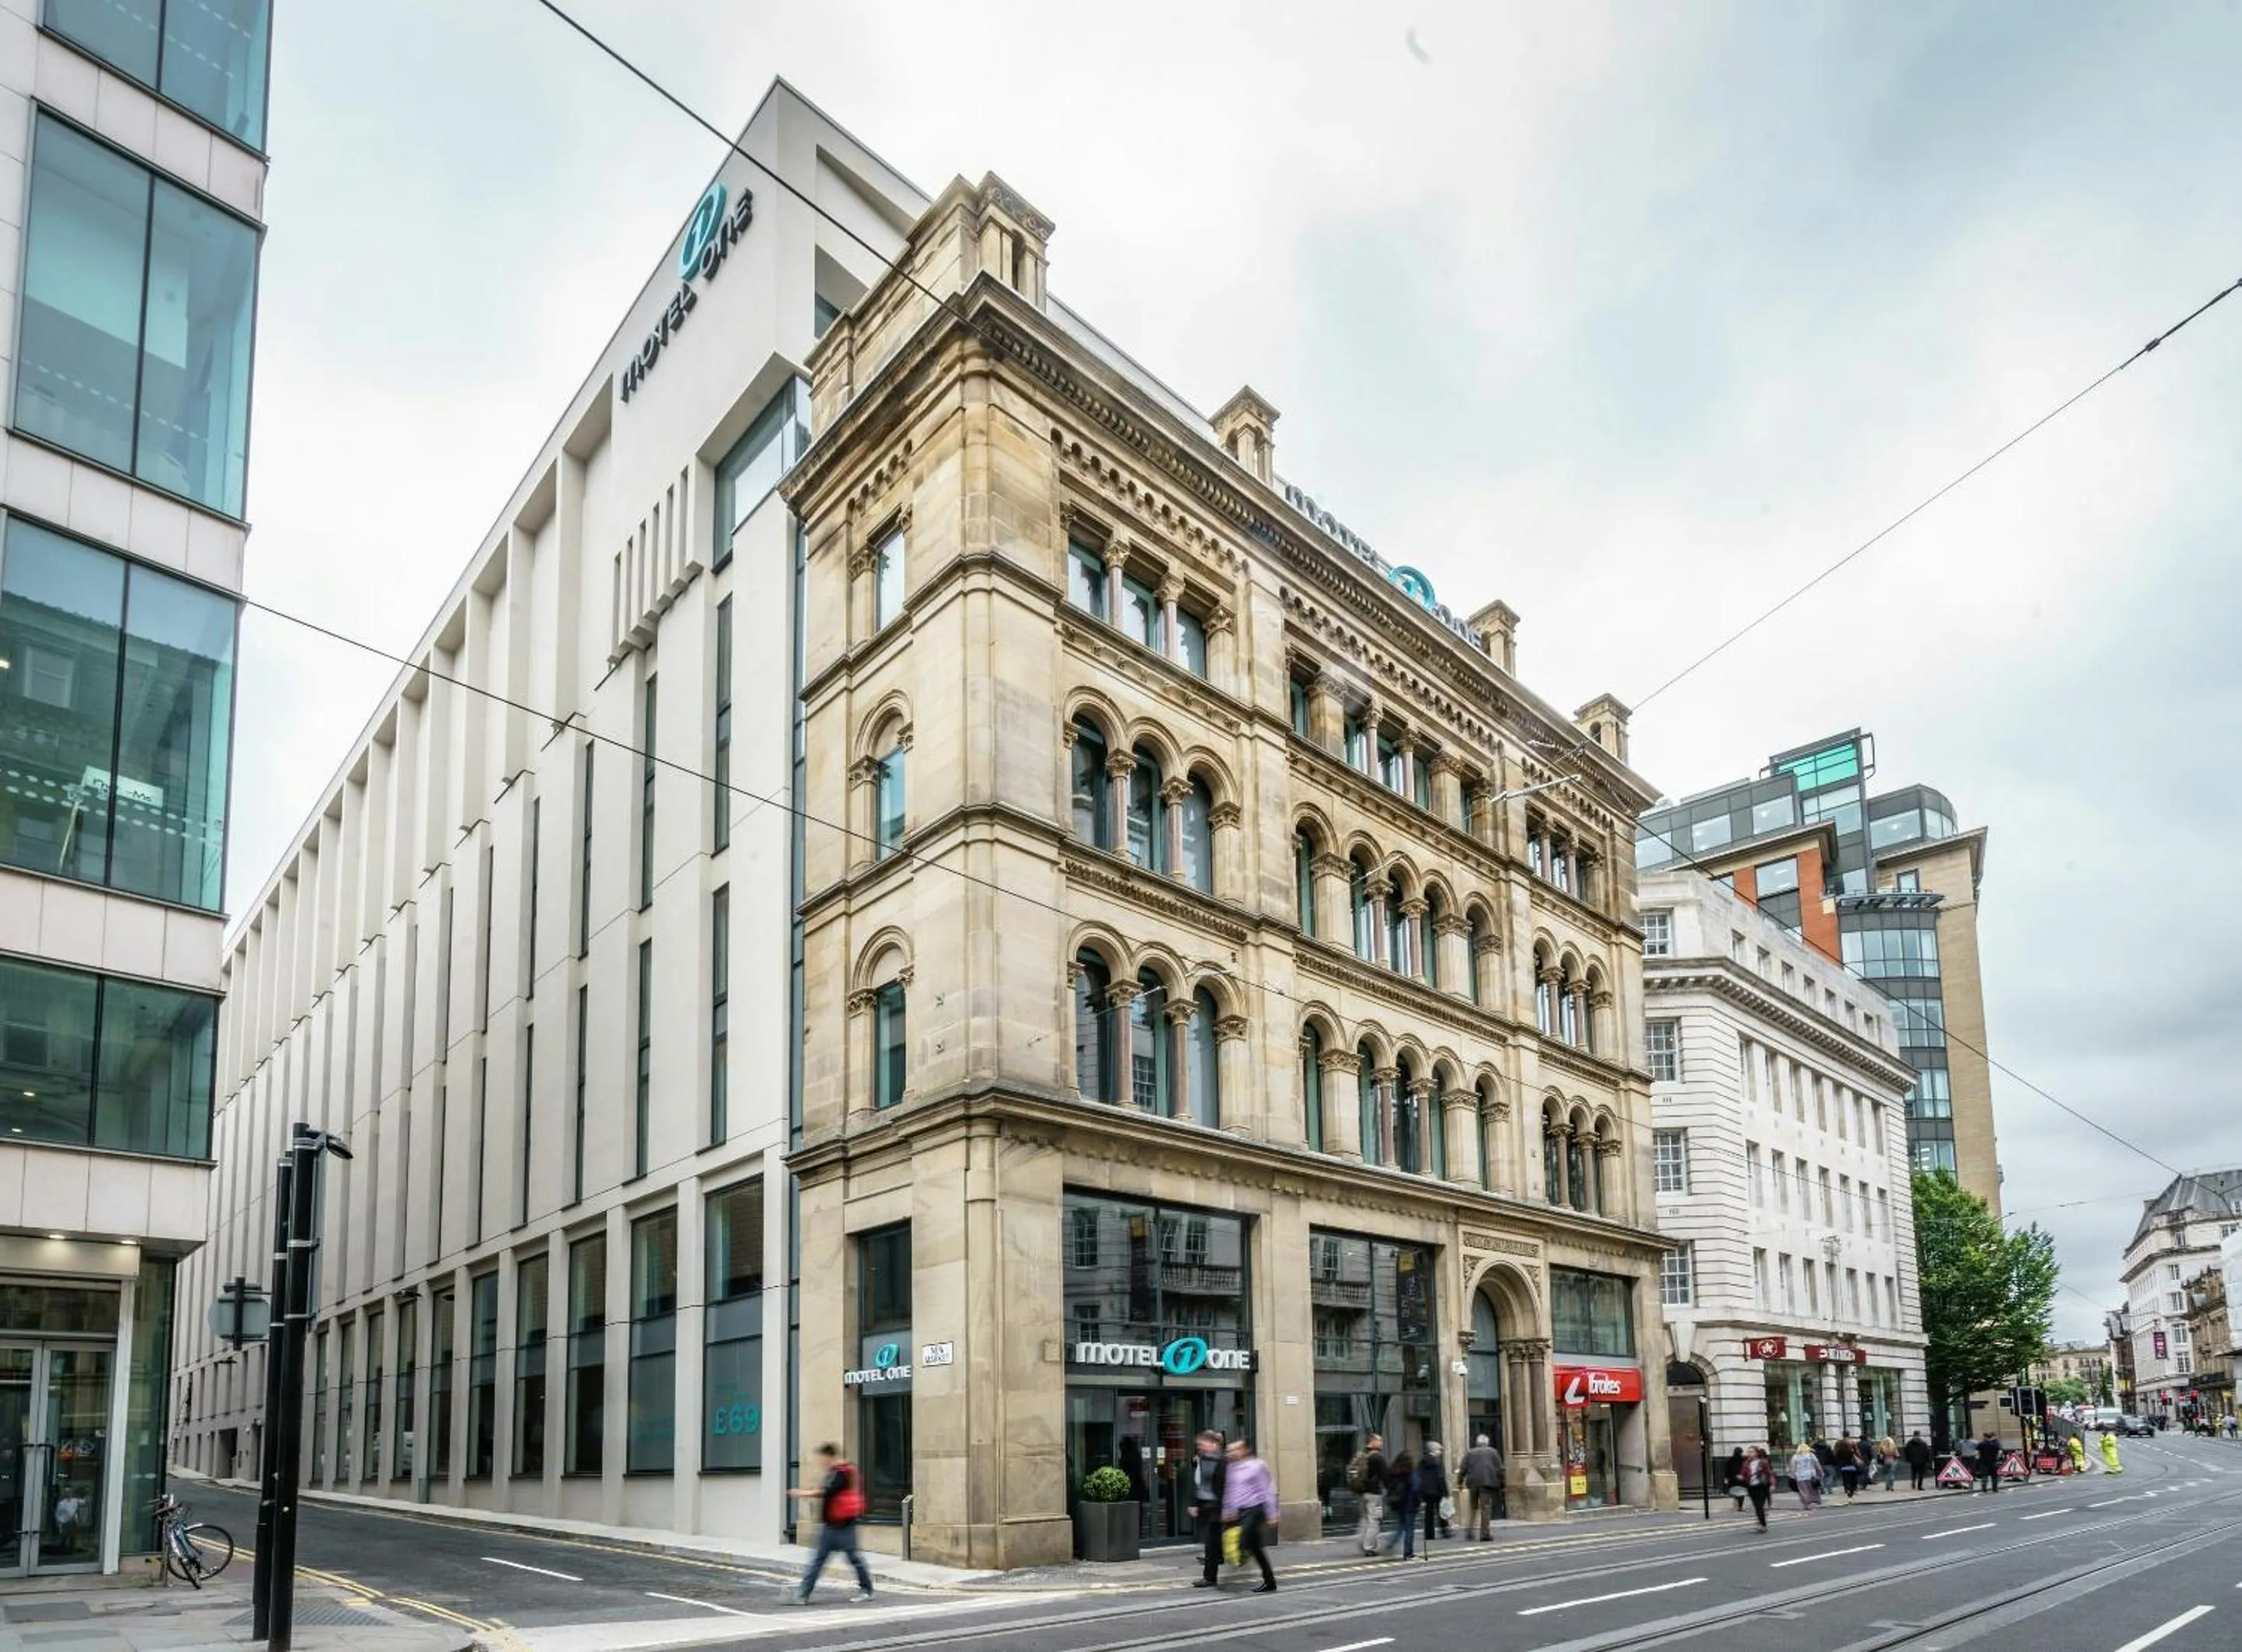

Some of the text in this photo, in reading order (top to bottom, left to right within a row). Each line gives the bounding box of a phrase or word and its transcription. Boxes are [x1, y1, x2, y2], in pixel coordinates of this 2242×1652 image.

[1076, 1342, 1165, 1367] MOTEL
[1207, 1349, 1250, 1369] ONE
[844, 1366, 911, 1384] MOTEL ONE
